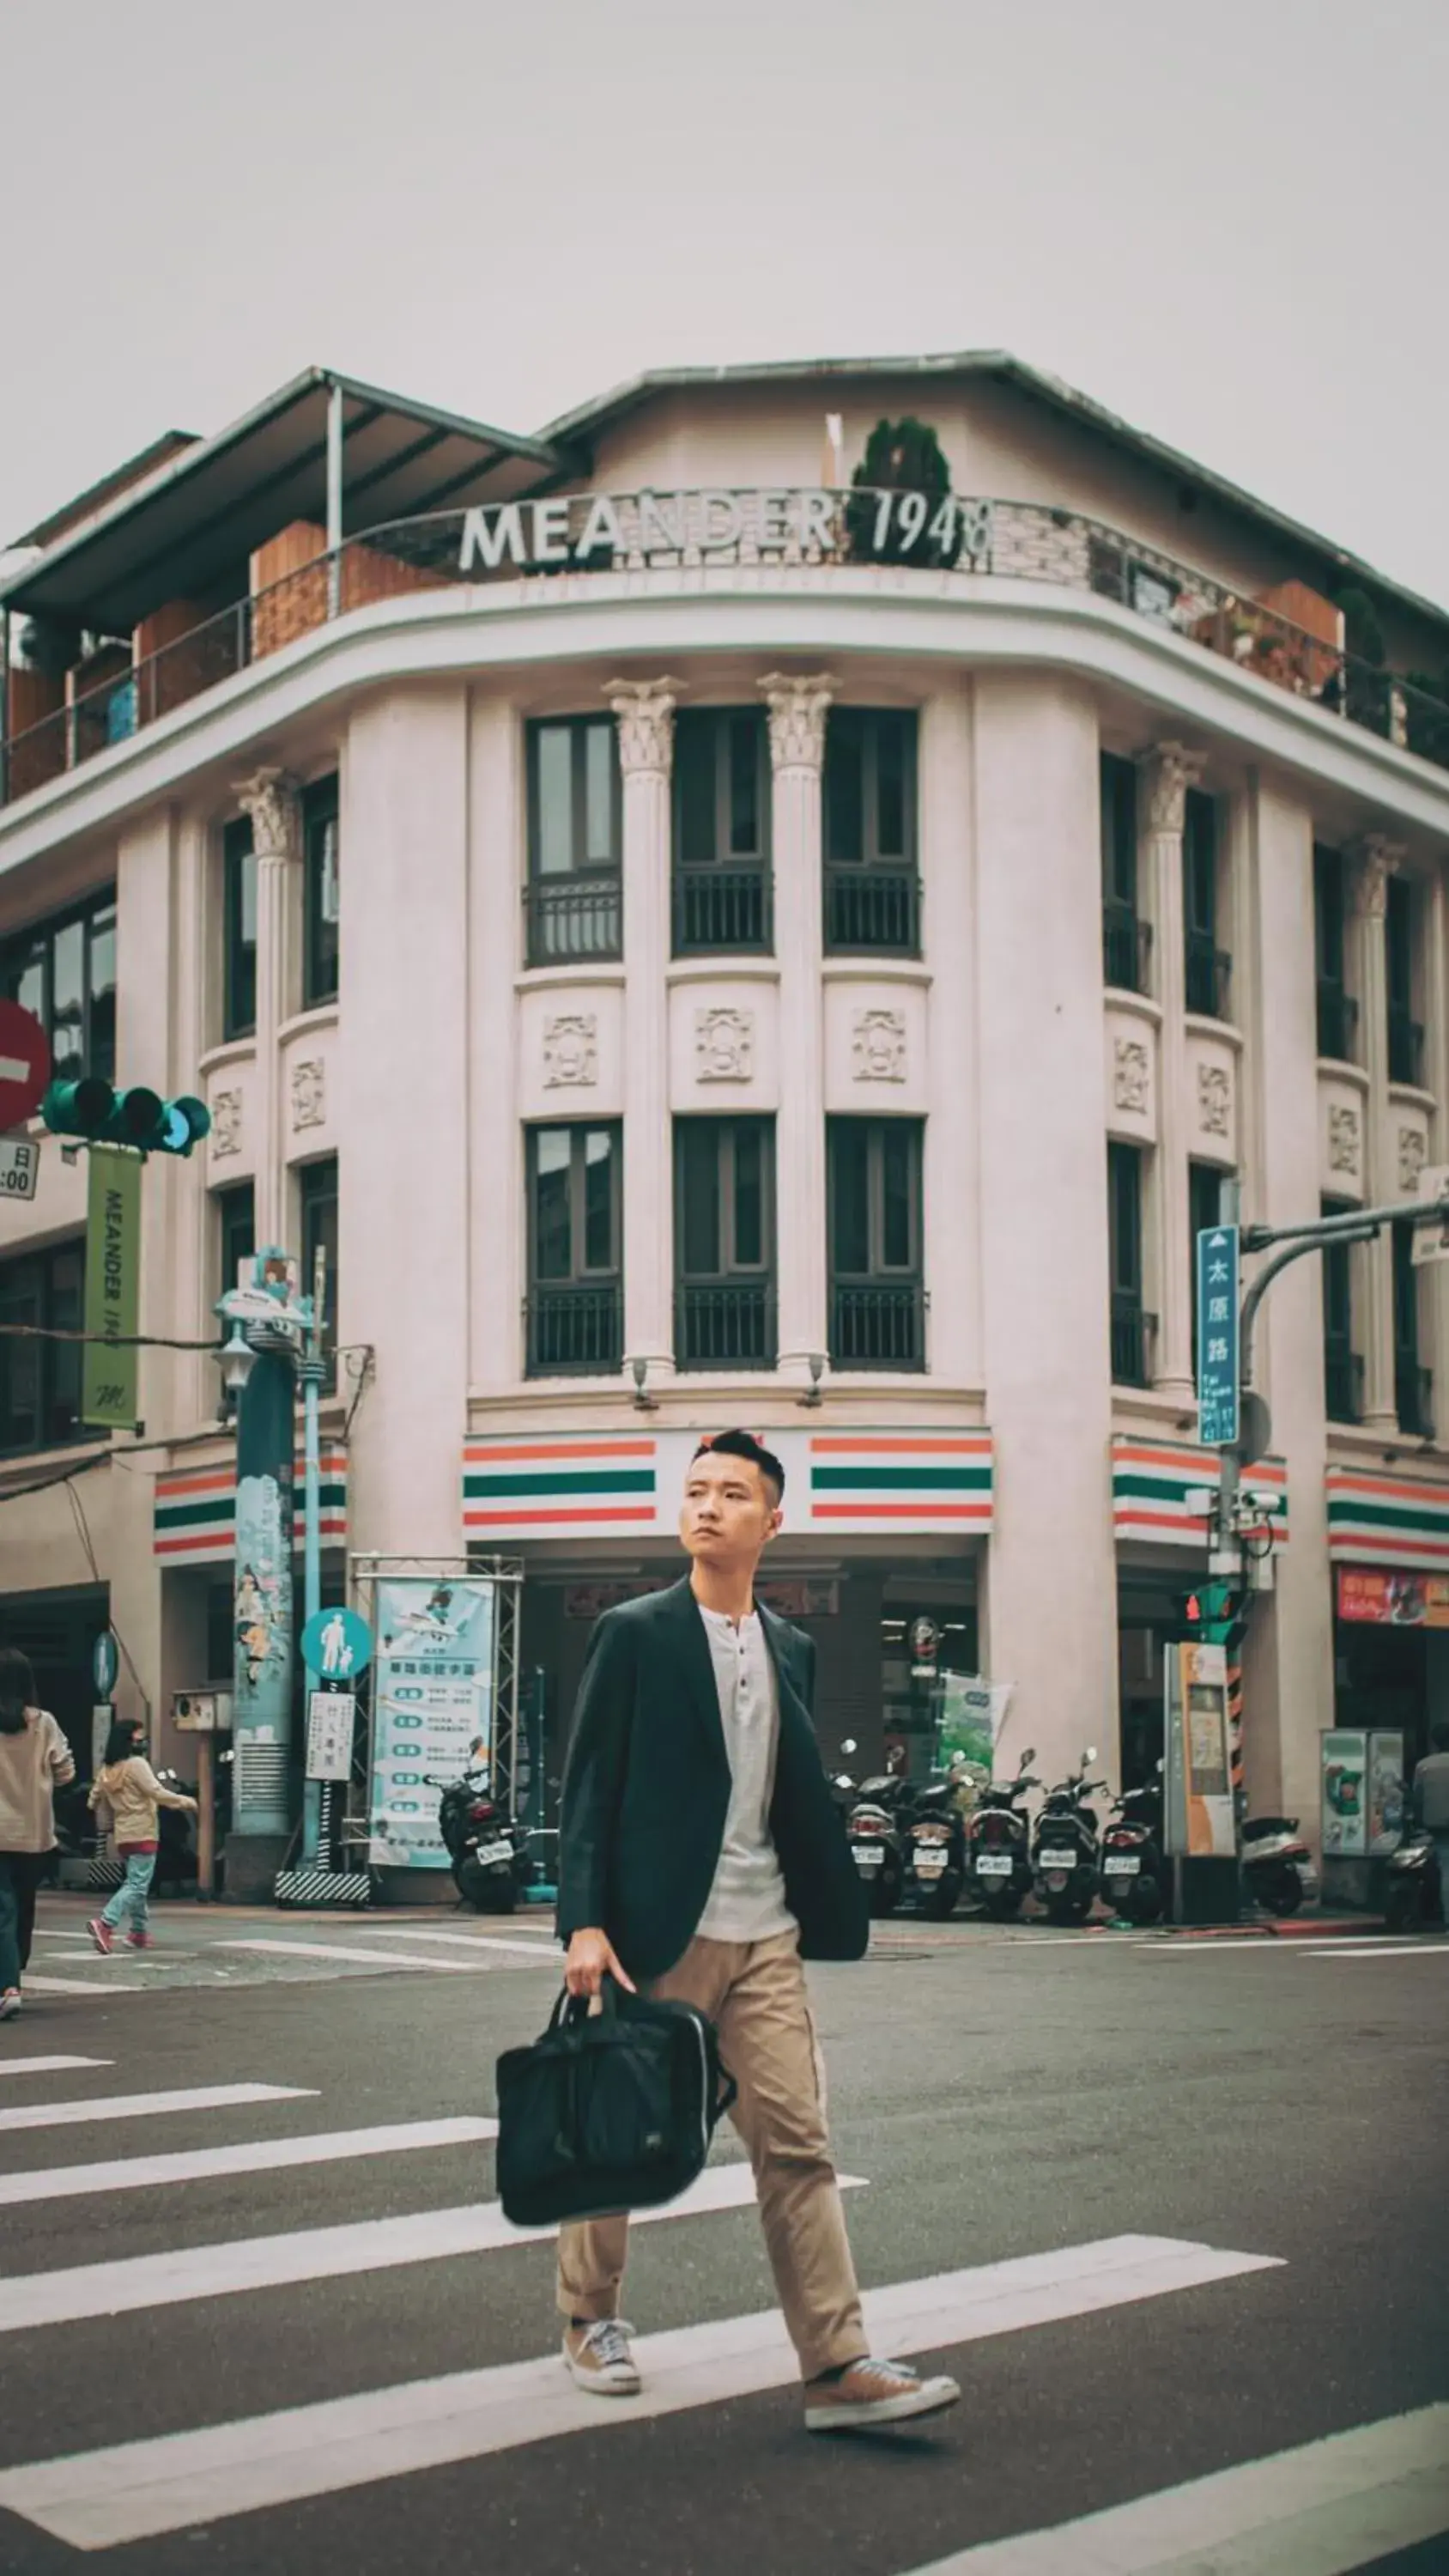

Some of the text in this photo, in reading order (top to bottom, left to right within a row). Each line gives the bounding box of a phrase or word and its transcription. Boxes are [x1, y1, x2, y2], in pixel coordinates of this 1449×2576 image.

[458, 489, 995, 572] MEANDER 1948
[15, 1145, 30, 1169] 日
[104, 1188, 123, 1301] MEANDER
[1207, 1256, 1229, 1363] 太原路
